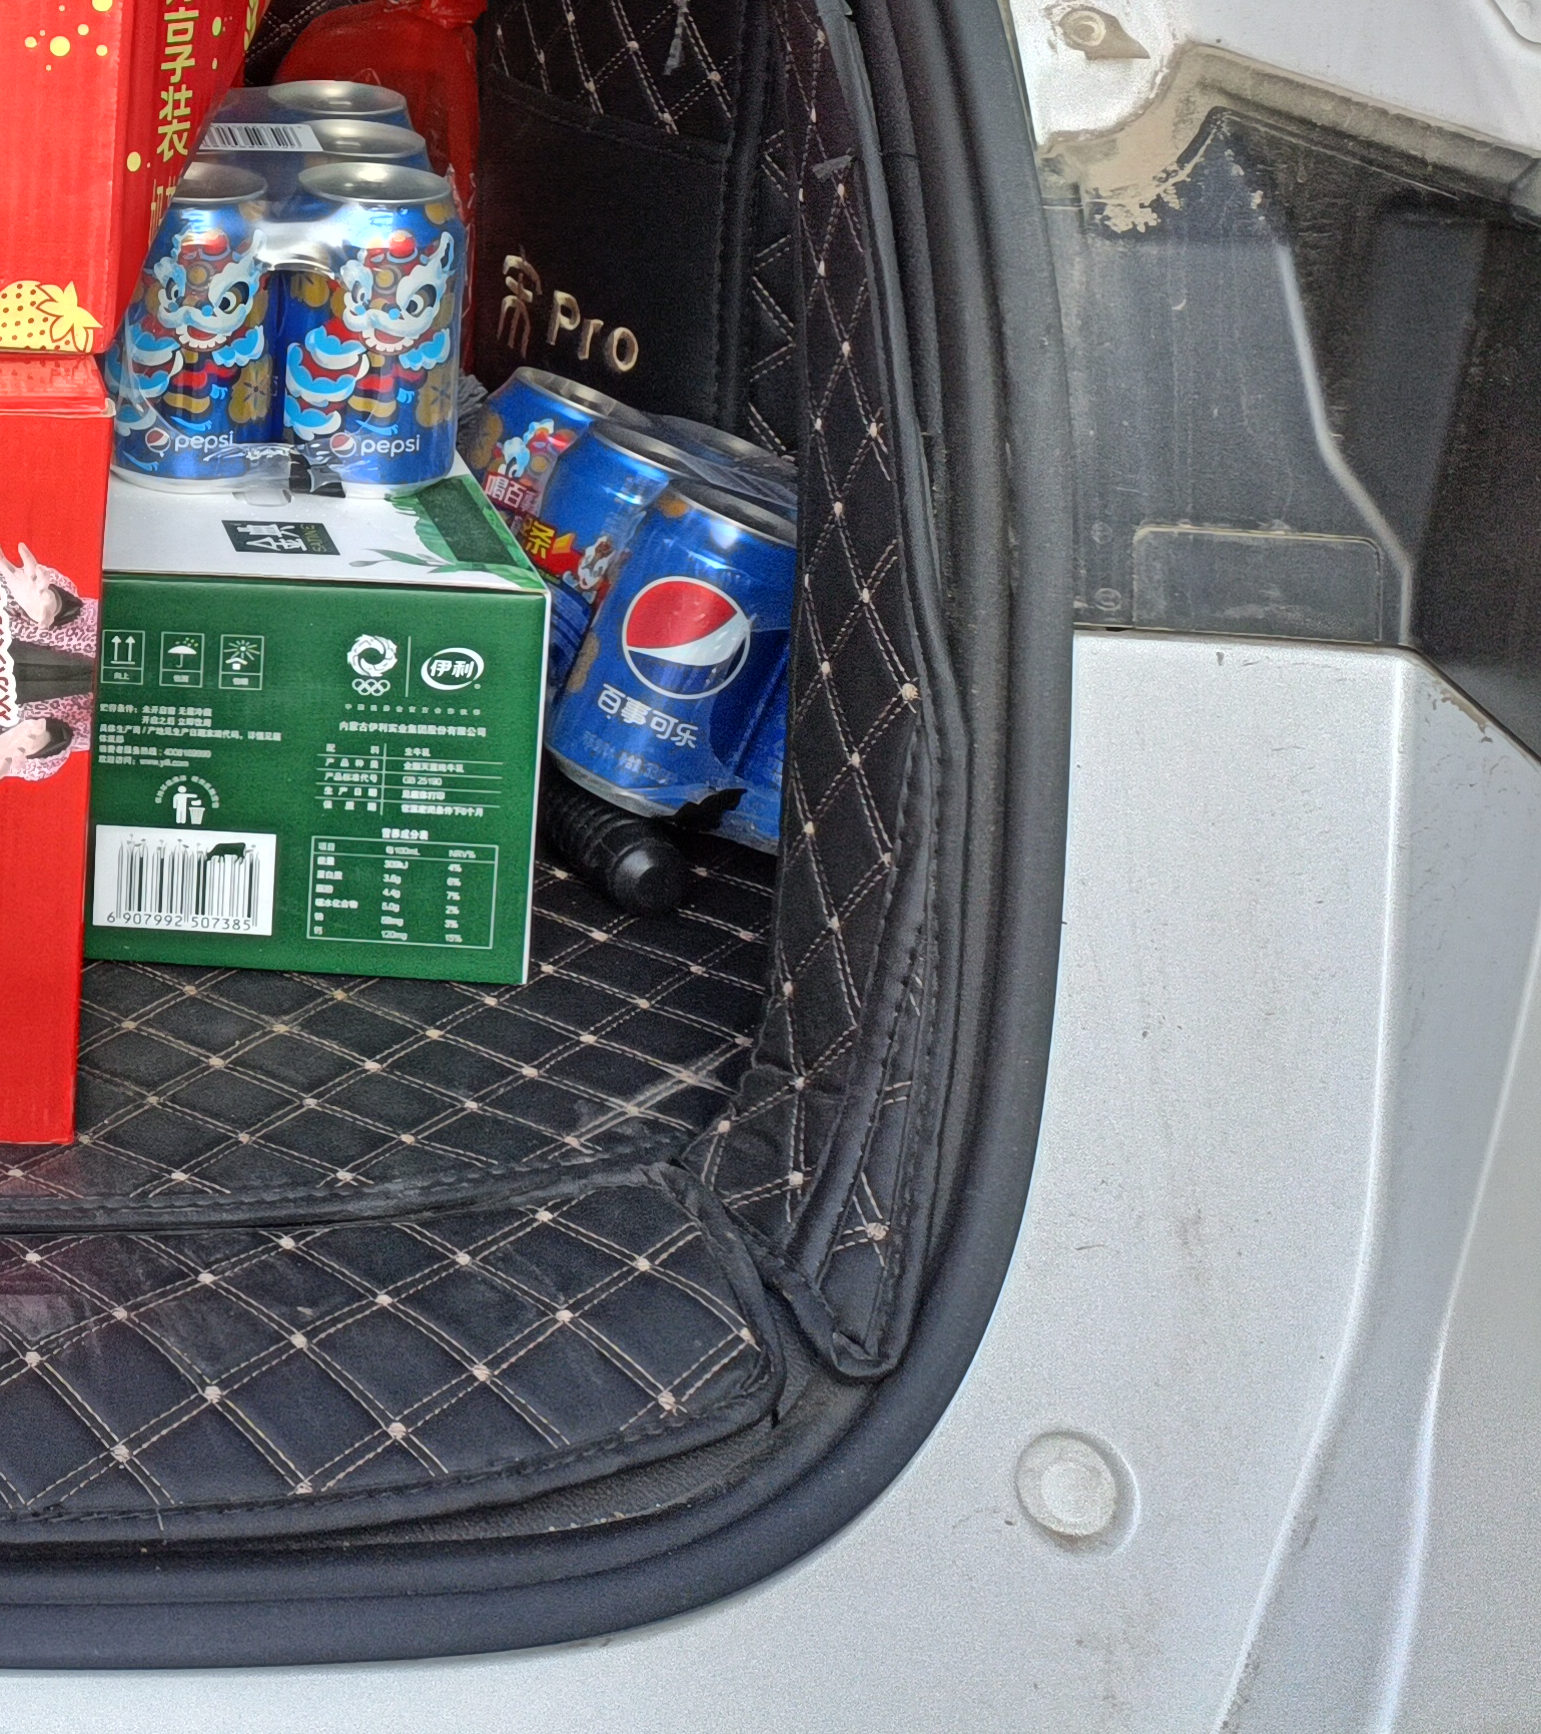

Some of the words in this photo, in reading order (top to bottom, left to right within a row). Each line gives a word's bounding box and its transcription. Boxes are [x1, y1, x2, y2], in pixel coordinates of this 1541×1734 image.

[174, 430, 235, 453] pepsi
[360, 433, 421, 456] pepsi
[236, 523, 308, 552] 金典
[429, 659, 475, 678] 伊利
[596, 682, 700, 750] 百事可乐
[106, 911, 116, 924] 6
[123, 912, 183, 928] 907992
[190, 914, 251, 931] 507385
